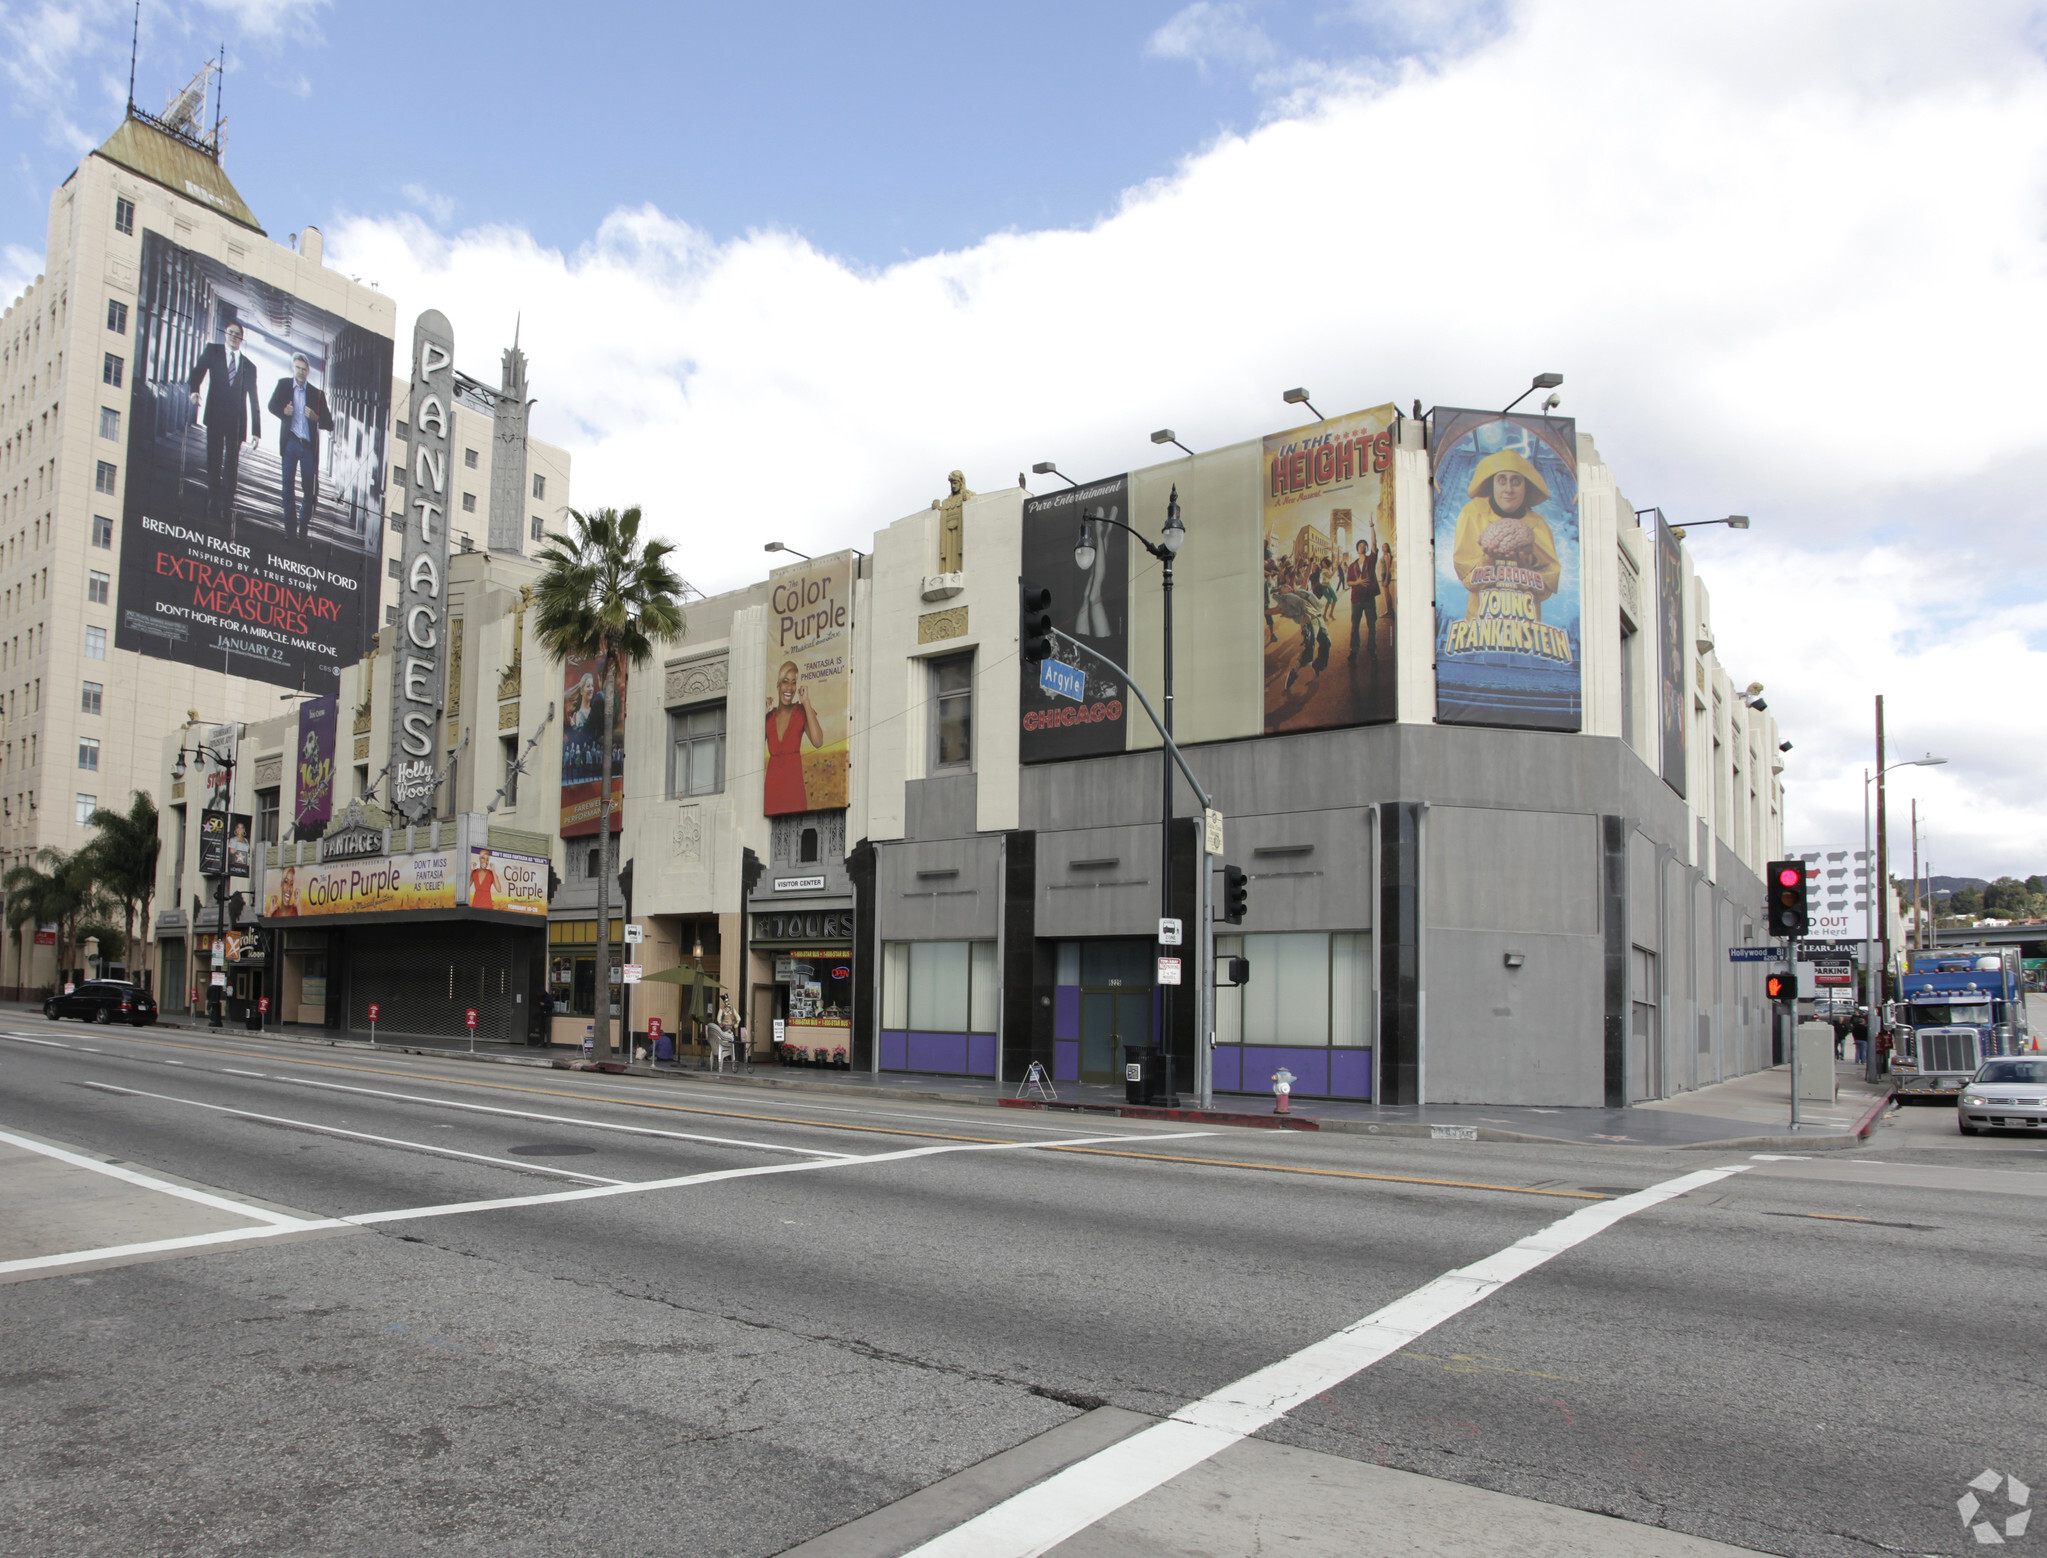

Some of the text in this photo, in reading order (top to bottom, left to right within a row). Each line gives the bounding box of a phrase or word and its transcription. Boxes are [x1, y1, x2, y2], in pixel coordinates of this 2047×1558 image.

[1279, 433, 1332, 456] IN THE
[1272, 431, 1392, 497] HEIGHTS
[1028, 480, 1121, 513] Pure Entertainment
[142, 516, 251, 559] BRENDAN FRASER
[402, 340, 451, 758] PANTAGES
[188, 548, 318, 592] INSPIRED BY A TRUE STORY
[267, 553, 358, 591] HARRISON FORD
[1470, 565, 1544, 590] MEL BROOKS
[156, 552, 342, 622] EXTRAORDINARY
[773, 577, 832, 615] Color
[193, 585, 308, 635] MEASURES
[1479, 588, 1536, 622] YOUNG
[155, 601, 190, 618] DON'T
[191, 610, 218, 626] HOPE
[220, 618, 239, 632] FOR
[241, 624, 249, 634] A
[249, 625, 290, 645] MIRACLE.
[291, 637, 317, 651] MAKE
[318, 643, 338, 657] ONE.
[780, 599, 846, 647] Purple
[218, 635, 284, 660] JANUARY 22
[1445, 618, 1573, 665] FRANKENSTEIN
[318, 664, 332, 672] CBS
[837, 656, 843, 665] IS
[1045, 666, 1080, 693] Argyle
[1023, 699, 1123, 732] CHICAGO
[299, 758, 331, 790] 101
[395, 760, 434, 785] Holly
[323, 832, 382, 857] PANTAGES
[414, 858, 448, 870] DON'T MISS
[416, 870, 443, 880] FANTASIA
[503, 865, 536, 882] Color
[309, 861, 400, 906] Color Purple
[414, 883, 422, 891] AS
[508, 882, 543, 900] Purple
[799, 879, 822, 887] CENTER
[773, 914, 853, 938] TOURS
[1820, 916, 1848, 927] OUT
[1822, 928, 1847, 936] Herd
[1730, 949, 1768, 958] Hollywood
[832, 969, 850, 977] OPEN
[1814, 967, 1849, 975] PARKING
